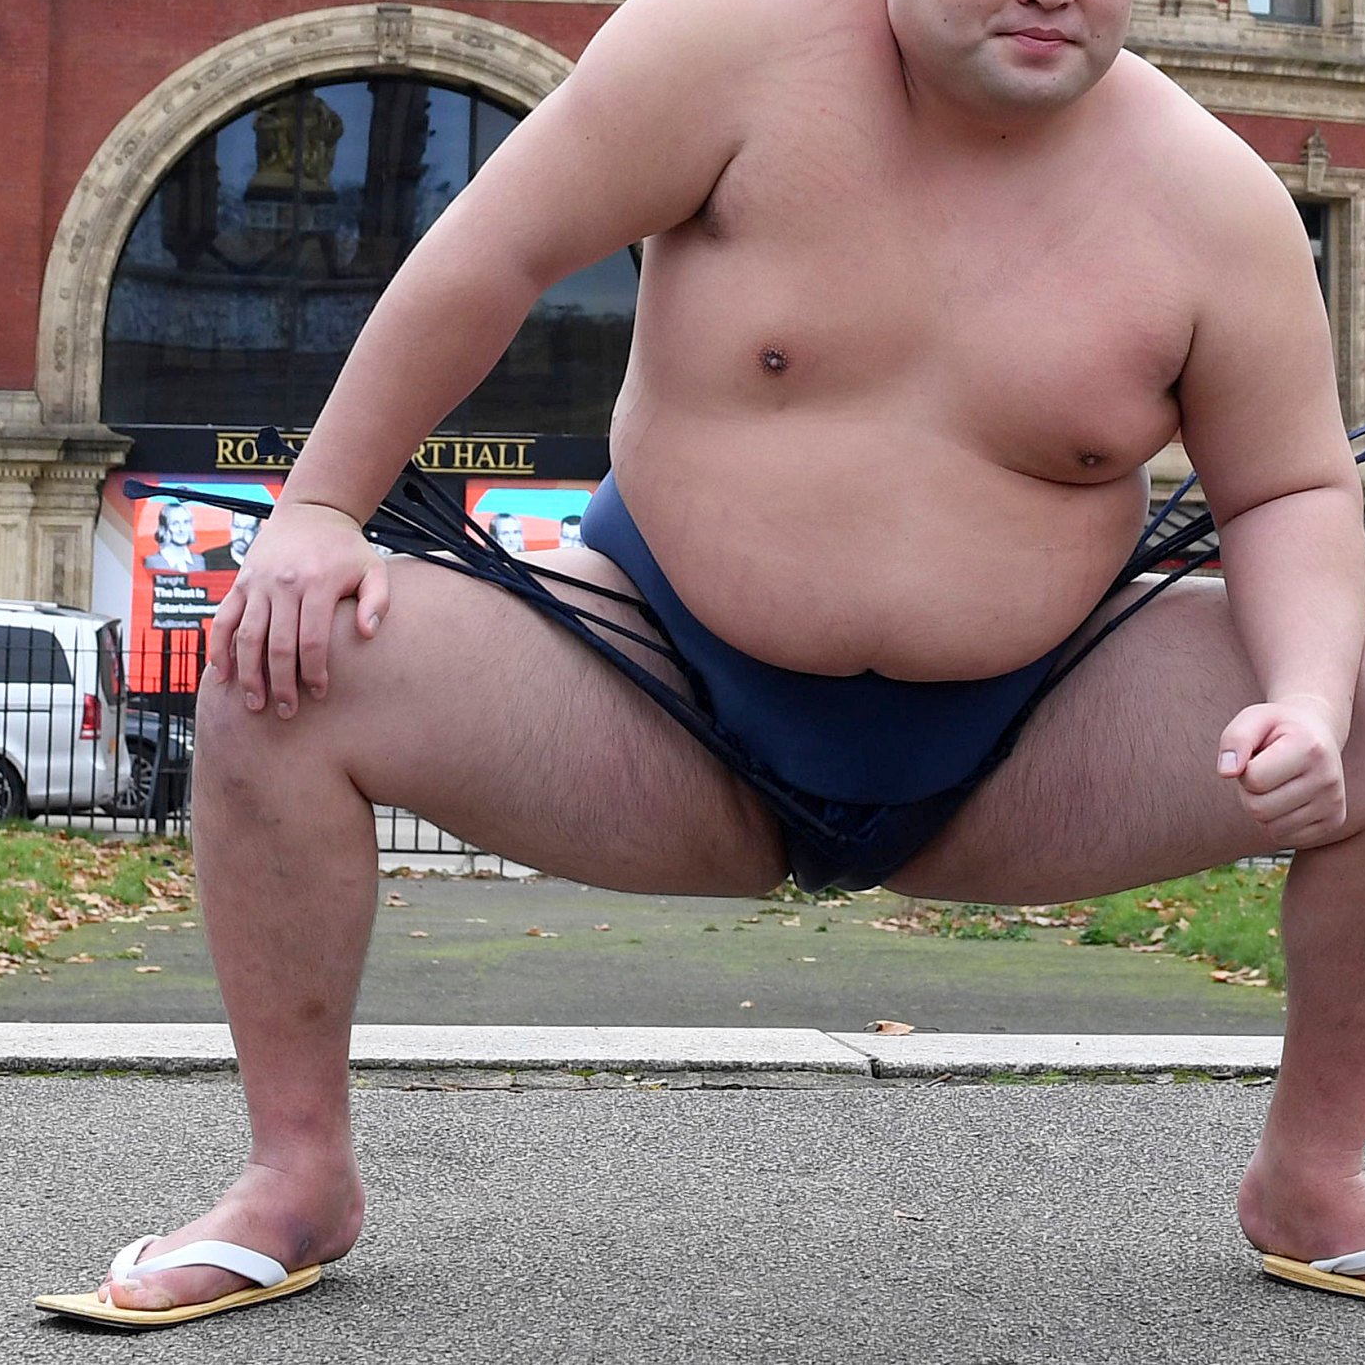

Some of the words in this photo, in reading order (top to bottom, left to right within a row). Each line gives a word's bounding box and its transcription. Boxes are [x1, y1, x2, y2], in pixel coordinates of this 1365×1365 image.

[453, 442, 535, 469] HALL
[154, 587, 174, 599] The
[173, 587, 195, 599] Rest
